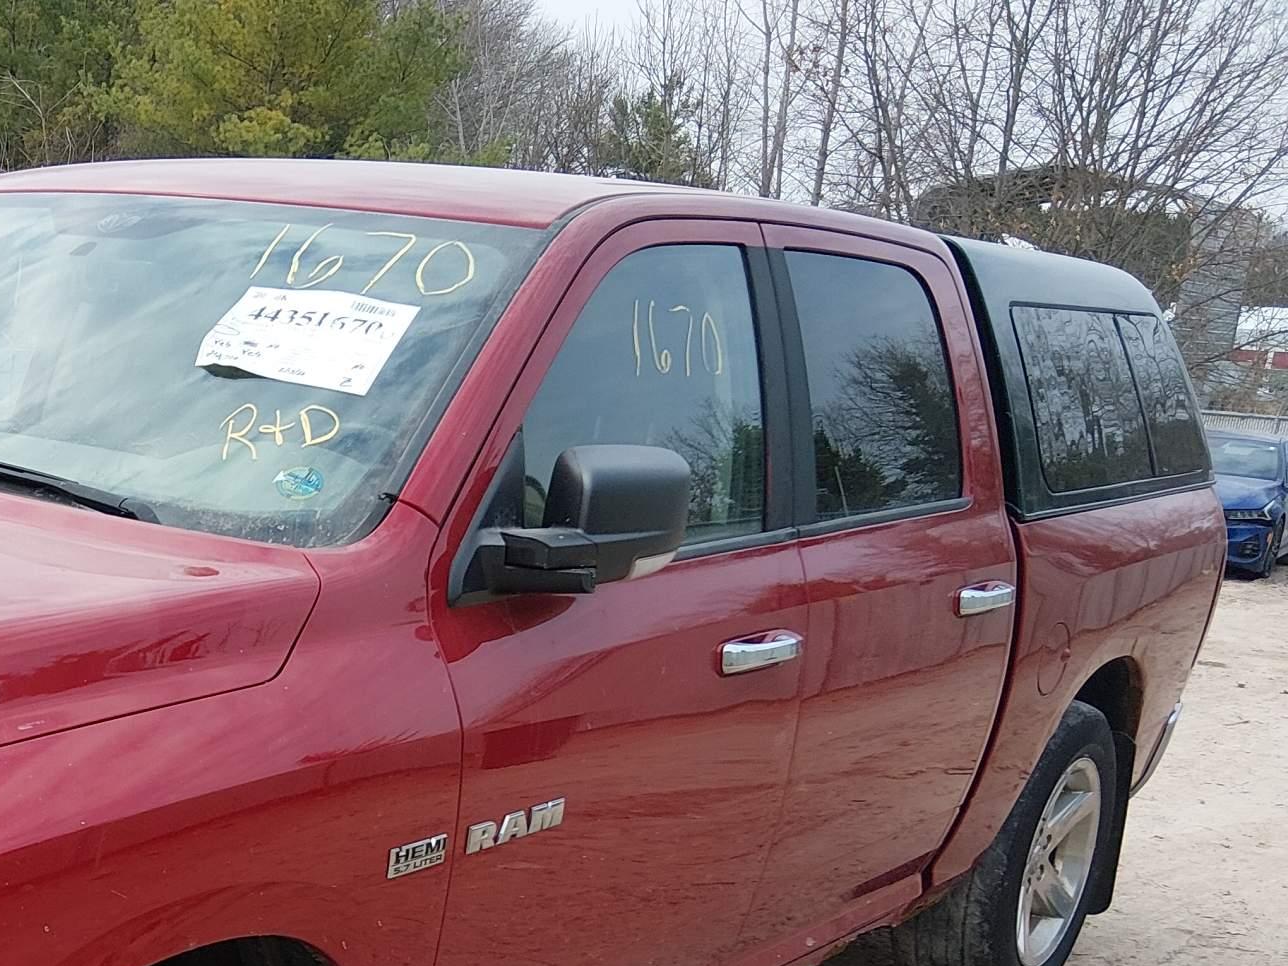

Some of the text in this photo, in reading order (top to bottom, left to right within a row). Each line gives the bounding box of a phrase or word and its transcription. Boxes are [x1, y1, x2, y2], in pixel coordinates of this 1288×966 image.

[249, 222, 476, 296] 1670
[632, 299, 723, 377] 1670
[394, 838, 447, 865] HEMI
[465, 797, 566, 856] RAM
[392, 853, 443, 876] 5.7 LITER
